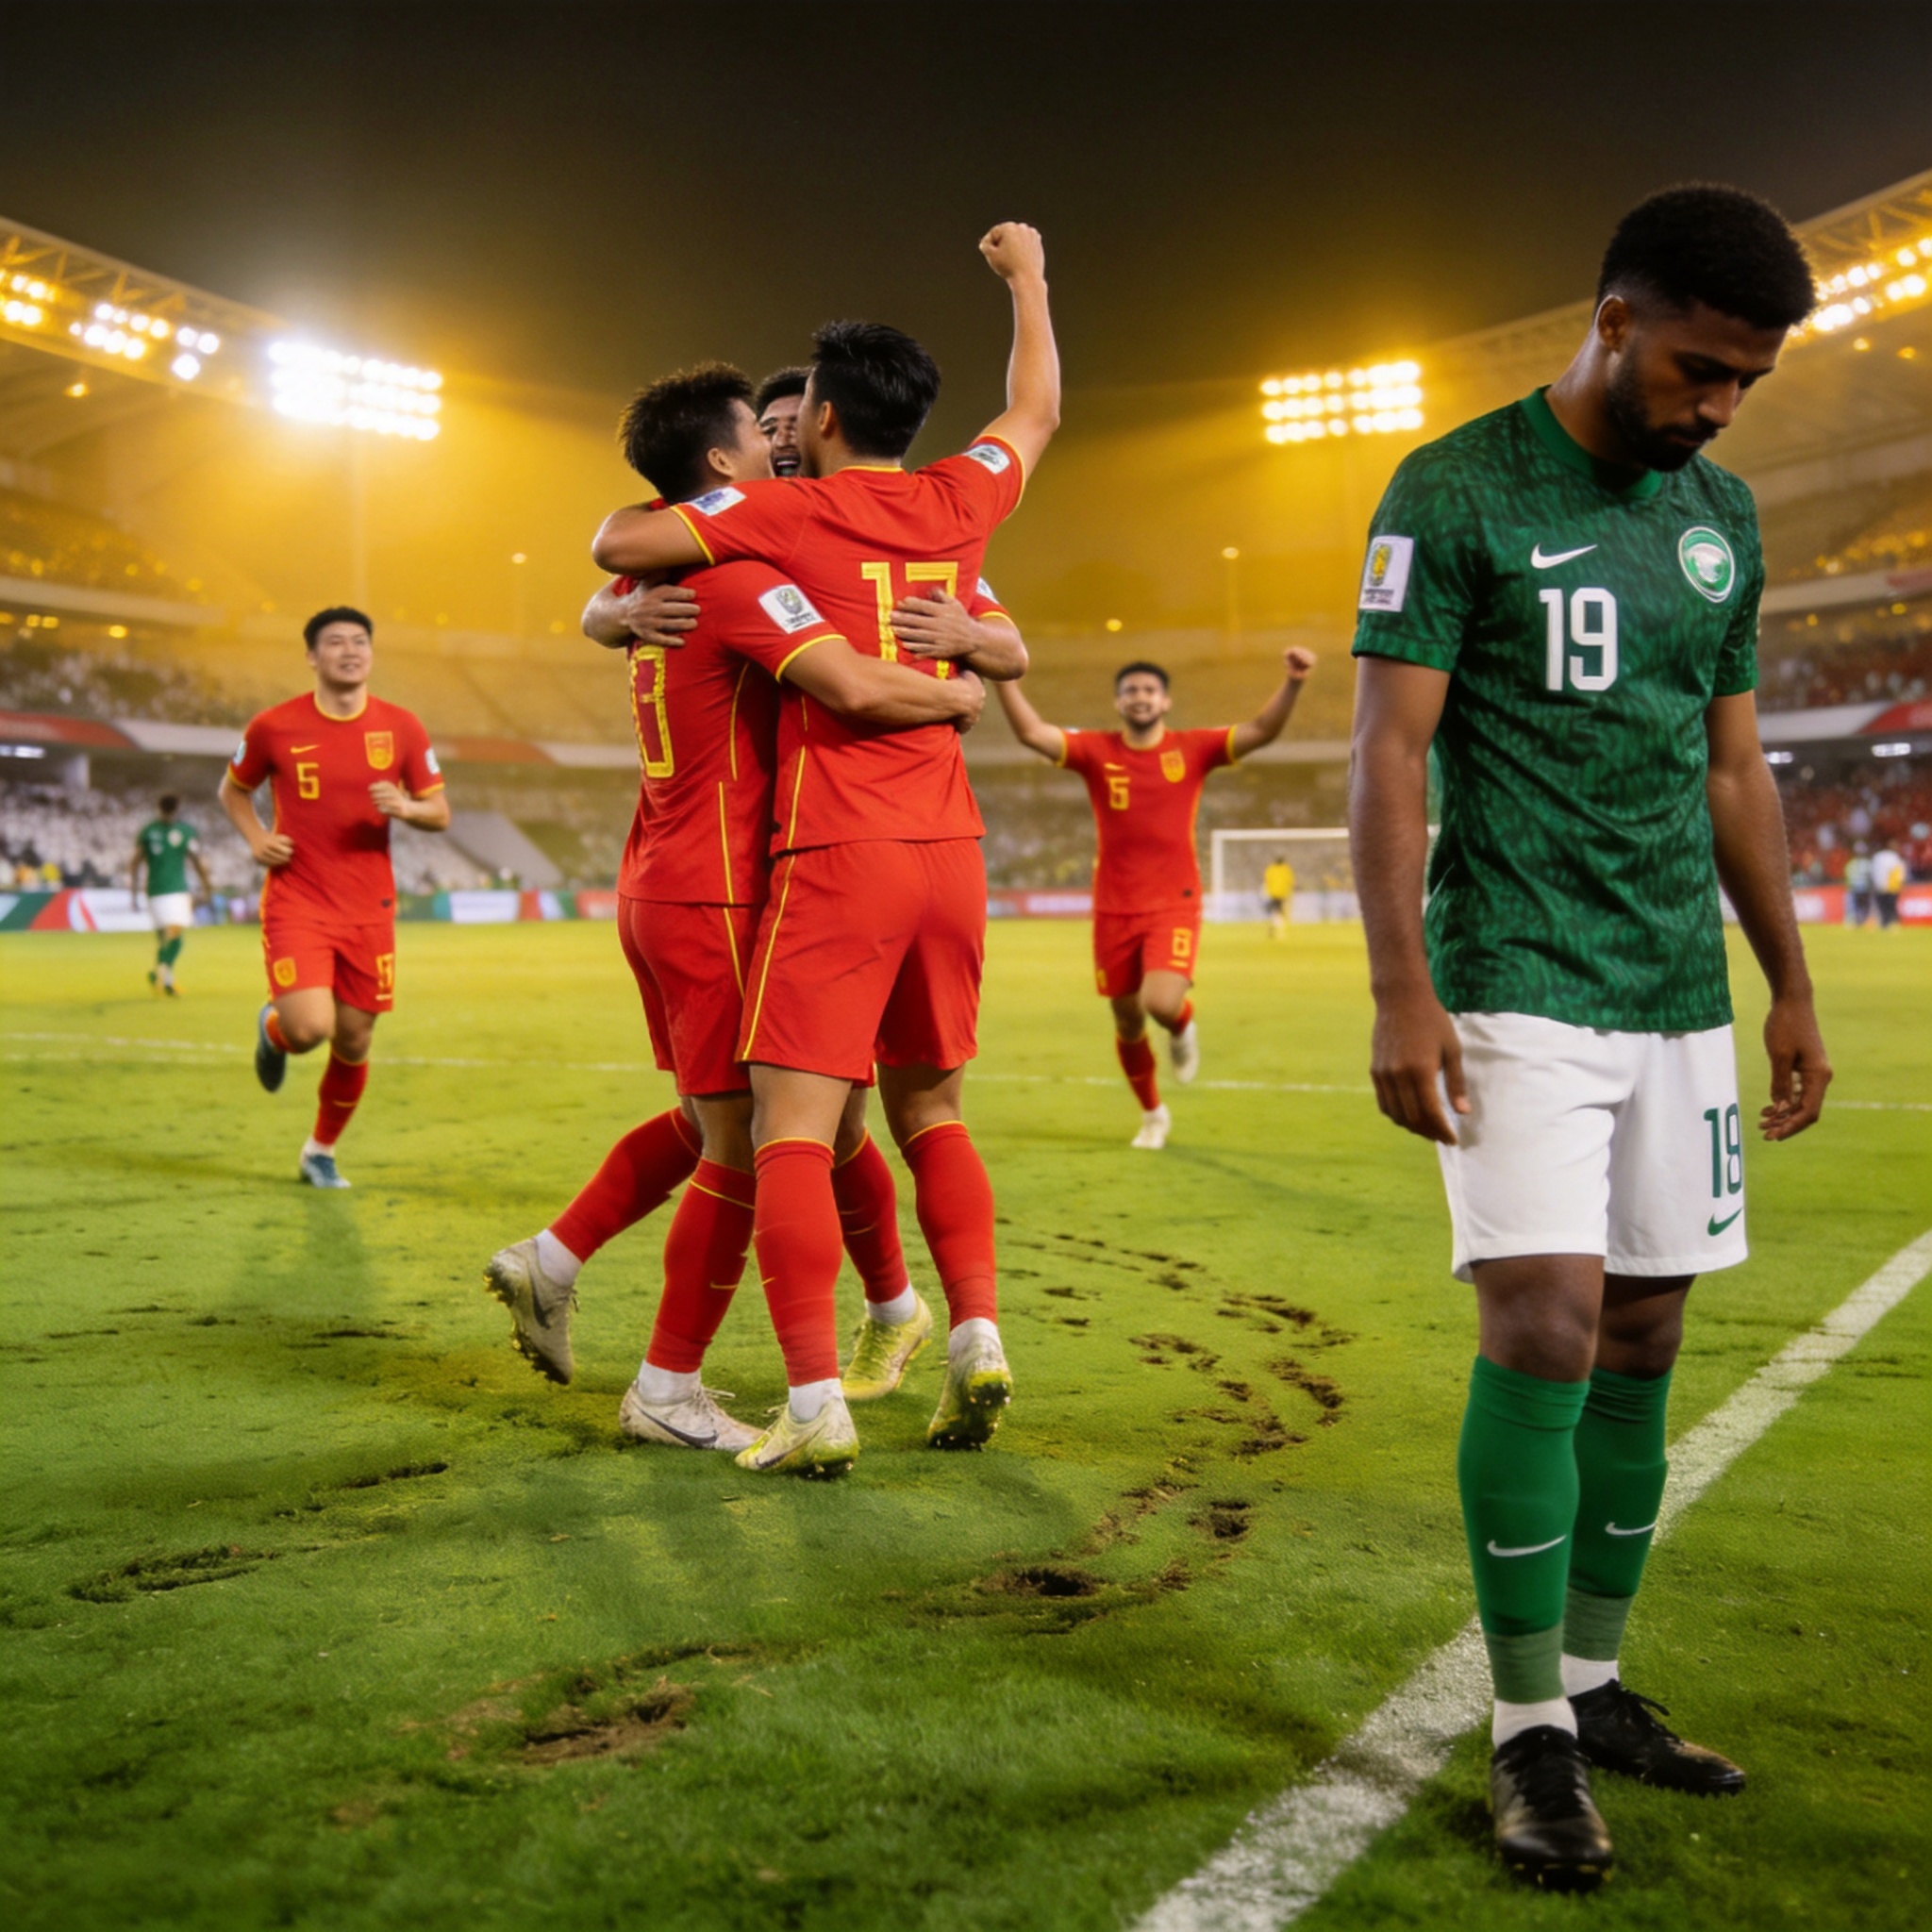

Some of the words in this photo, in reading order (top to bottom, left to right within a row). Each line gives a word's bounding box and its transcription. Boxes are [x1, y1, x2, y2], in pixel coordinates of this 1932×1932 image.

[1539, 587, 1618, 691] 19
[296, 761, 320, 800] 5
[1704, 1103, 1742, 1198] 18
